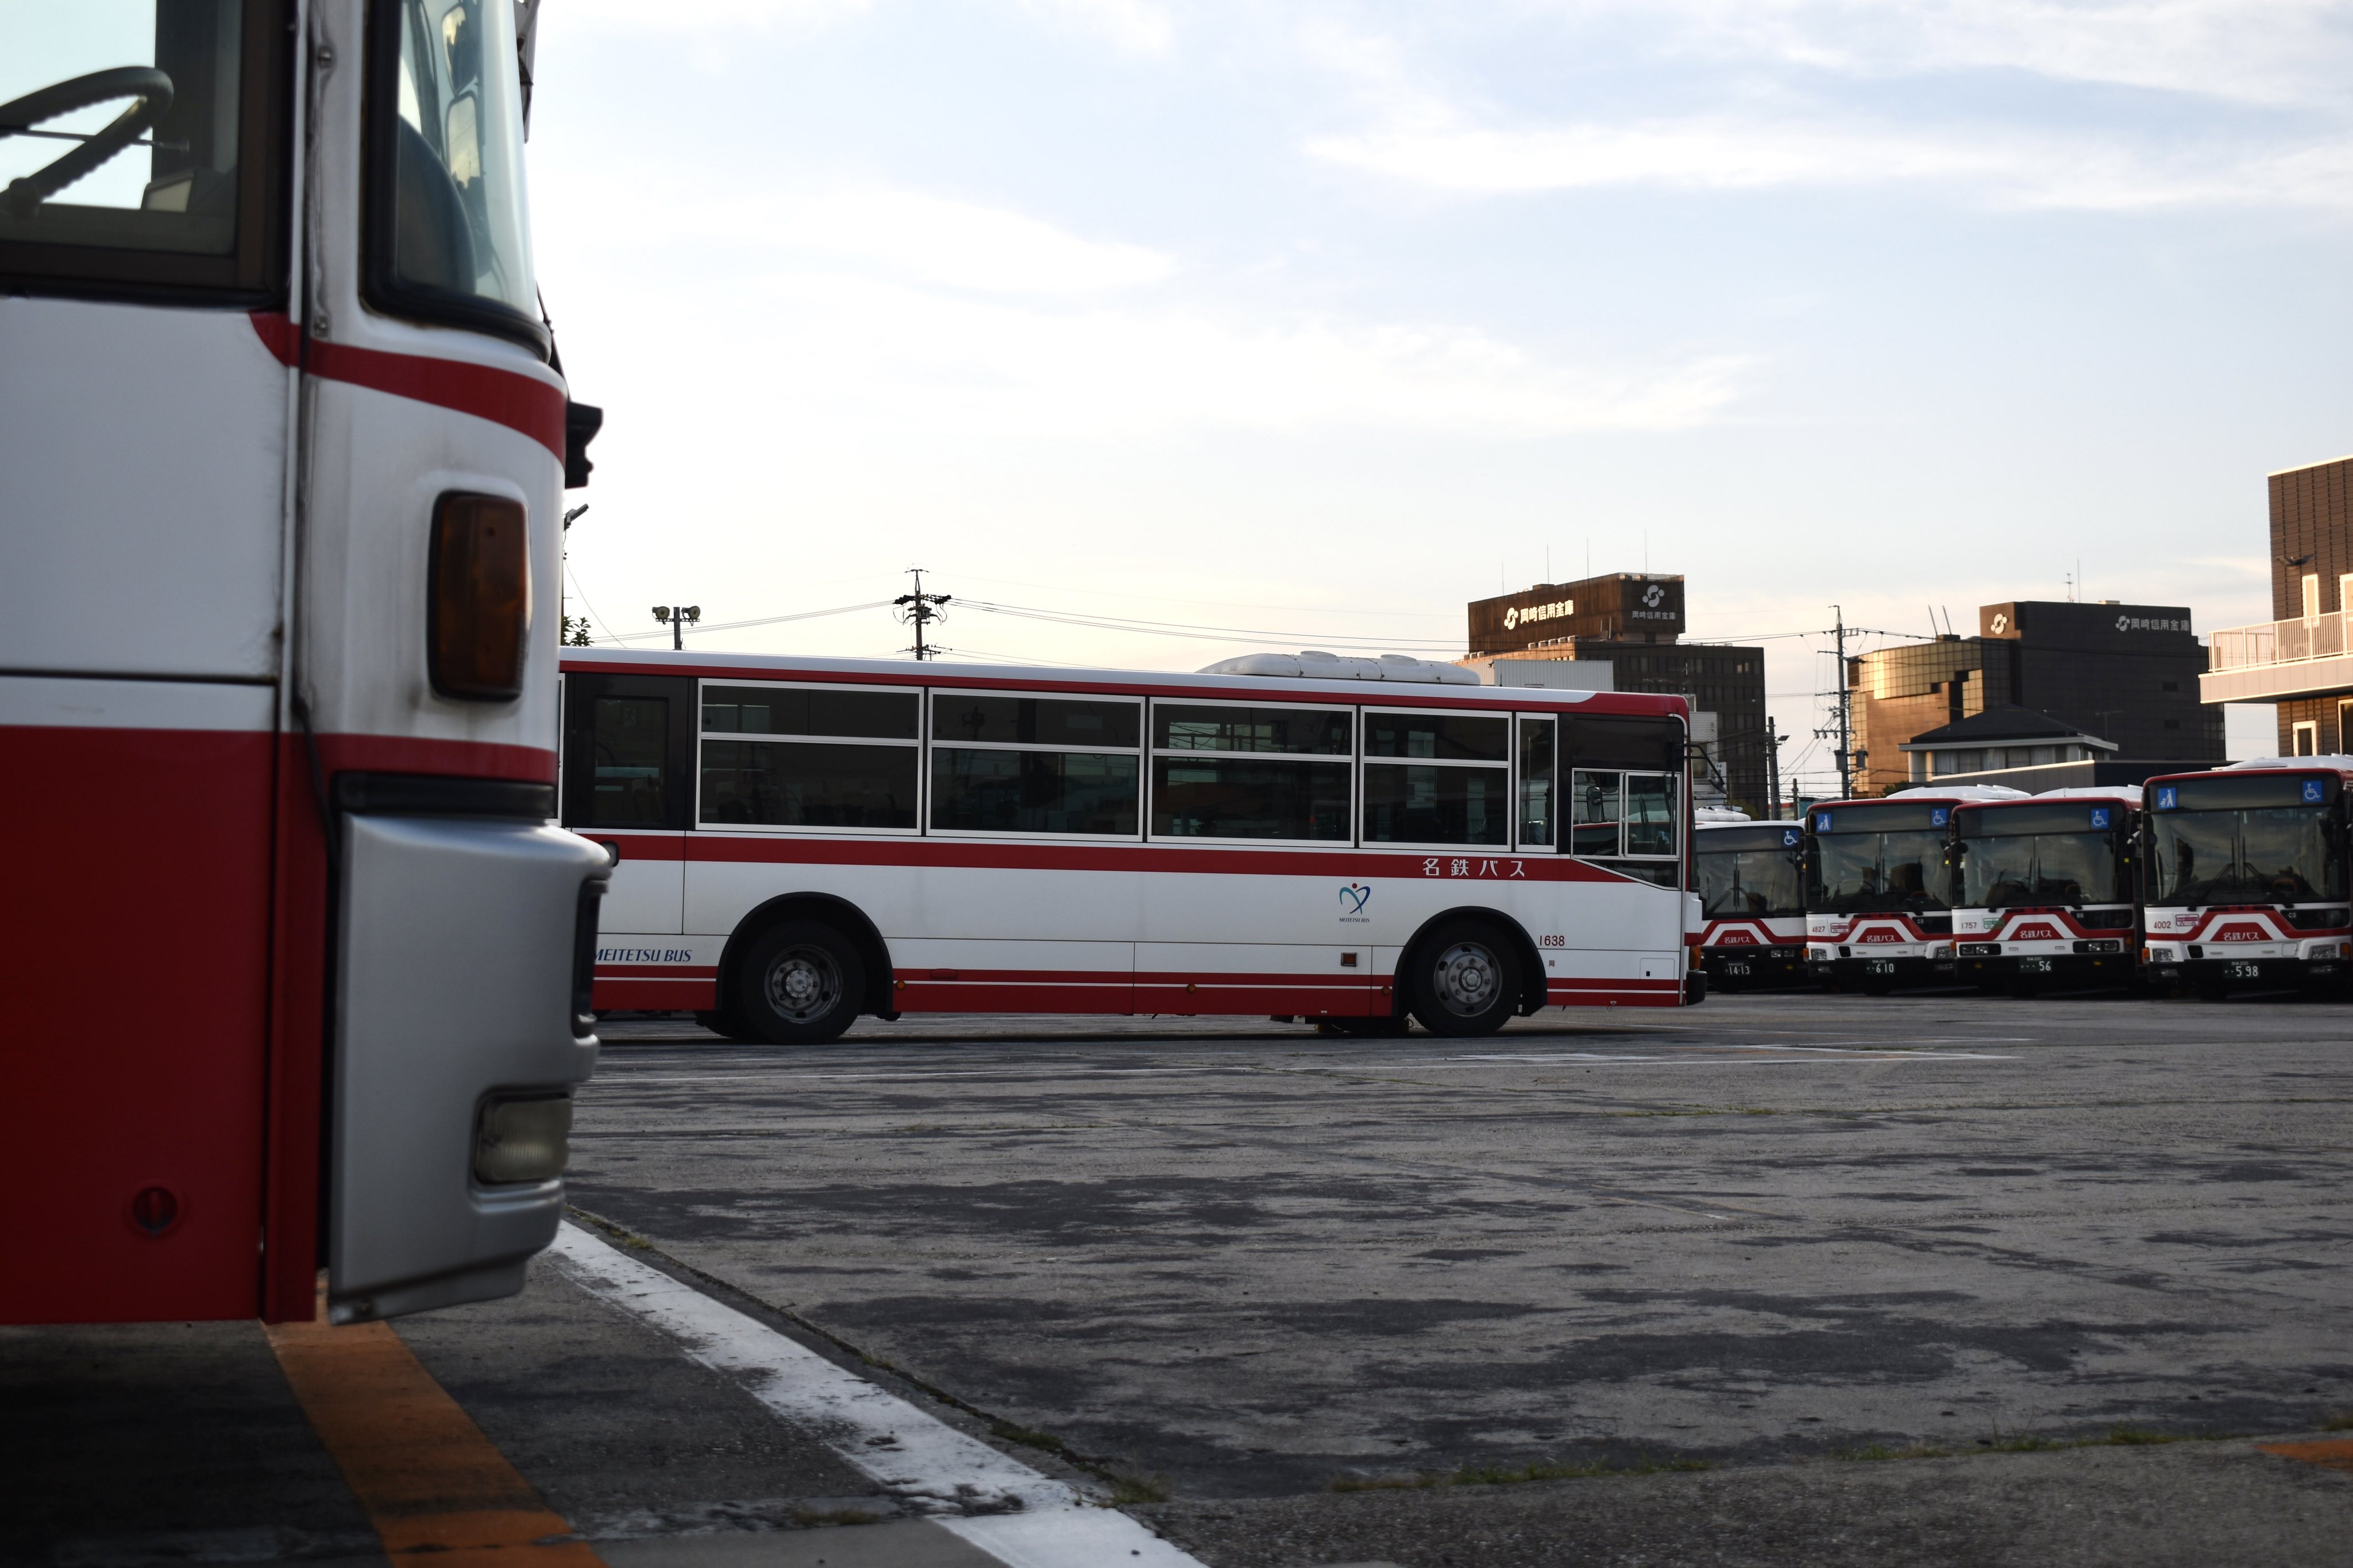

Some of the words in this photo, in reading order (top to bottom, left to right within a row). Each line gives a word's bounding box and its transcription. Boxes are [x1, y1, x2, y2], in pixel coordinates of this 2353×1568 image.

[1520, 600, 1574, 624] 岡崎信用金庫
[1631, 611, 1676, 620] 岡崎信用金庫
[2131, 618, 2190, 631] 岡崎信用金庫
[1422, 858, 1525, 877] 名鉄バス
[2154, 921, 2171, 929] 4002
[2020, 930, 2052, 939] 名鉄バス
[2223, 932, 2259, 941] 名鉄バス
[1540, 935, 1565, 946] 1638
[595, 949, 661, 961] MEITETSU
[664, 949, 692, 962] BUS
[2039, 961, 2051, 971] 56
